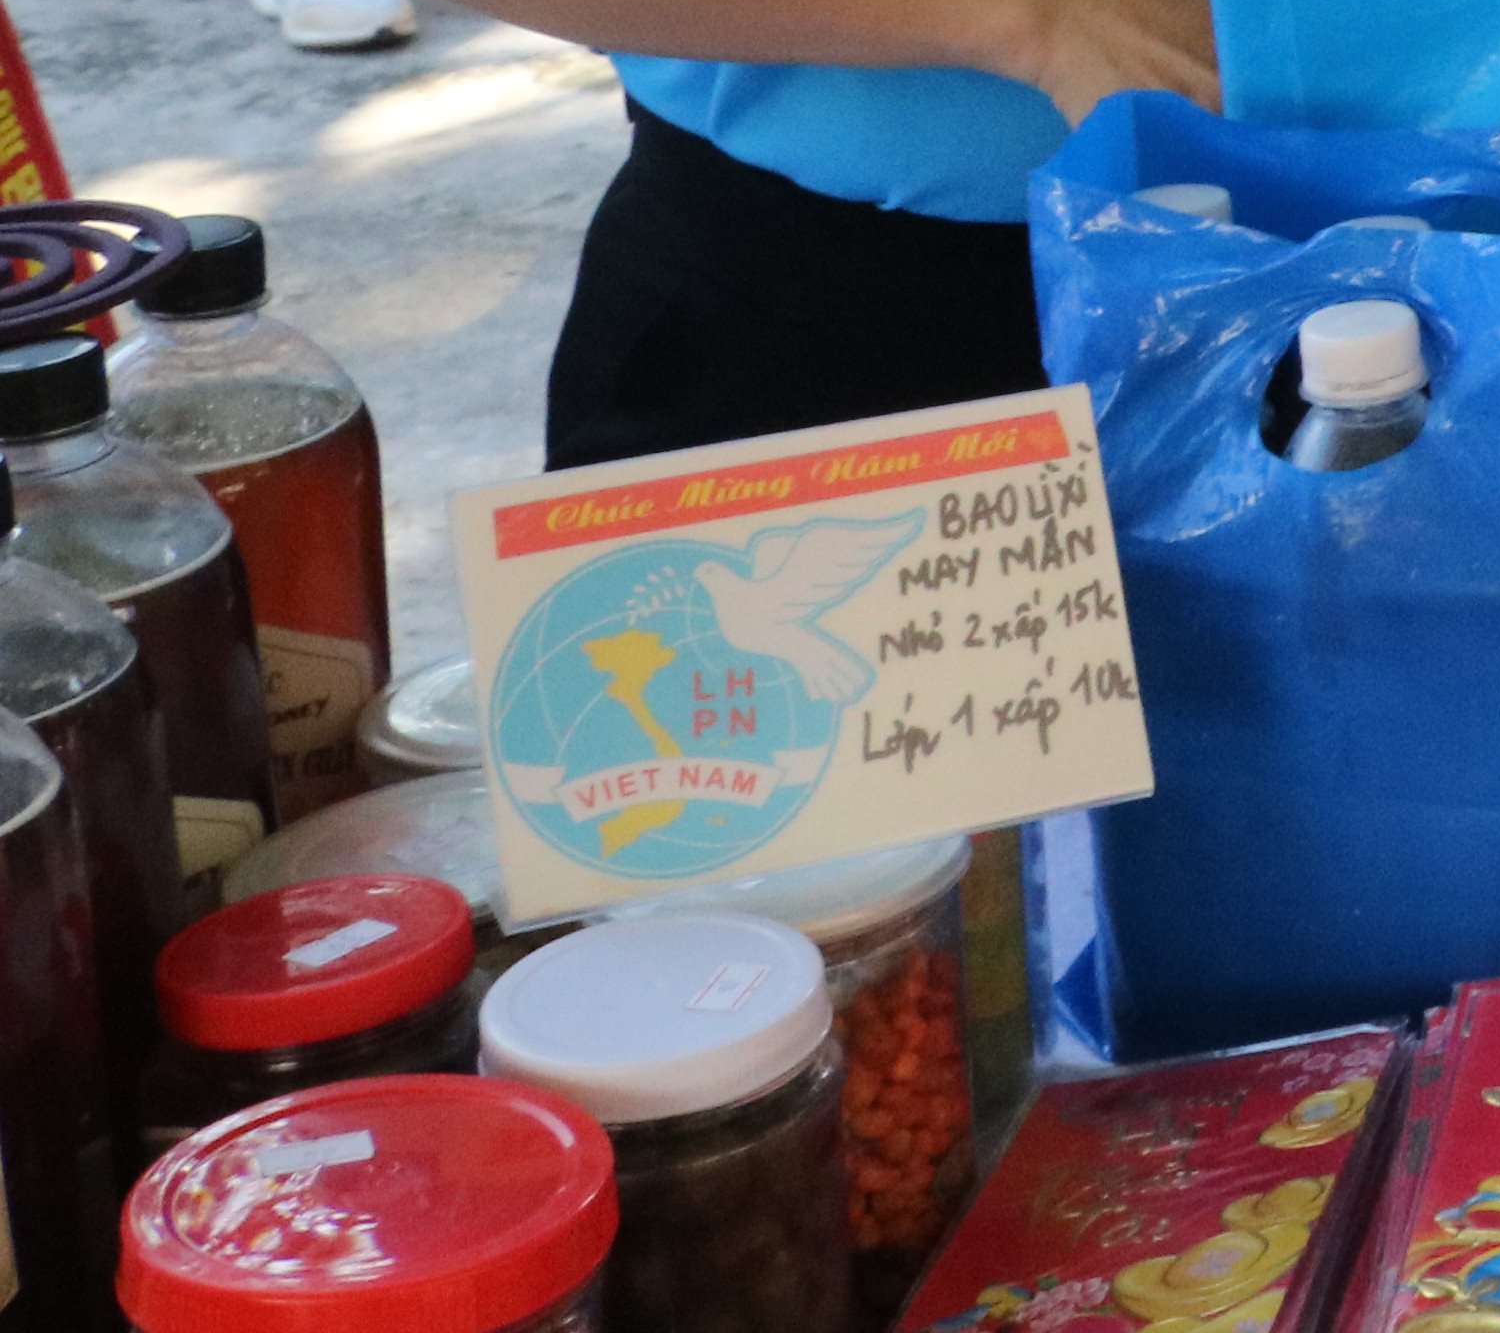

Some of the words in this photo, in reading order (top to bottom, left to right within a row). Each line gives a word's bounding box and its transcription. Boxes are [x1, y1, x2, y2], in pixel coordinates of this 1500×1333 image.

[544, 490, 654, 532] Chúc
[667, 472, 794, 514] Mừng
[809, 450, 923, 486] Năm
[932, 426, 1021, 464] Mới
[938, 483, 1020, 541] BAO
[898, 546, 982, 596] MAY
[961, 612, 987, 649] 2
[950, 692, 975, 737] 1
[574, 766, 661, 811] VIET
[678, 764, 760, 797] NAM
